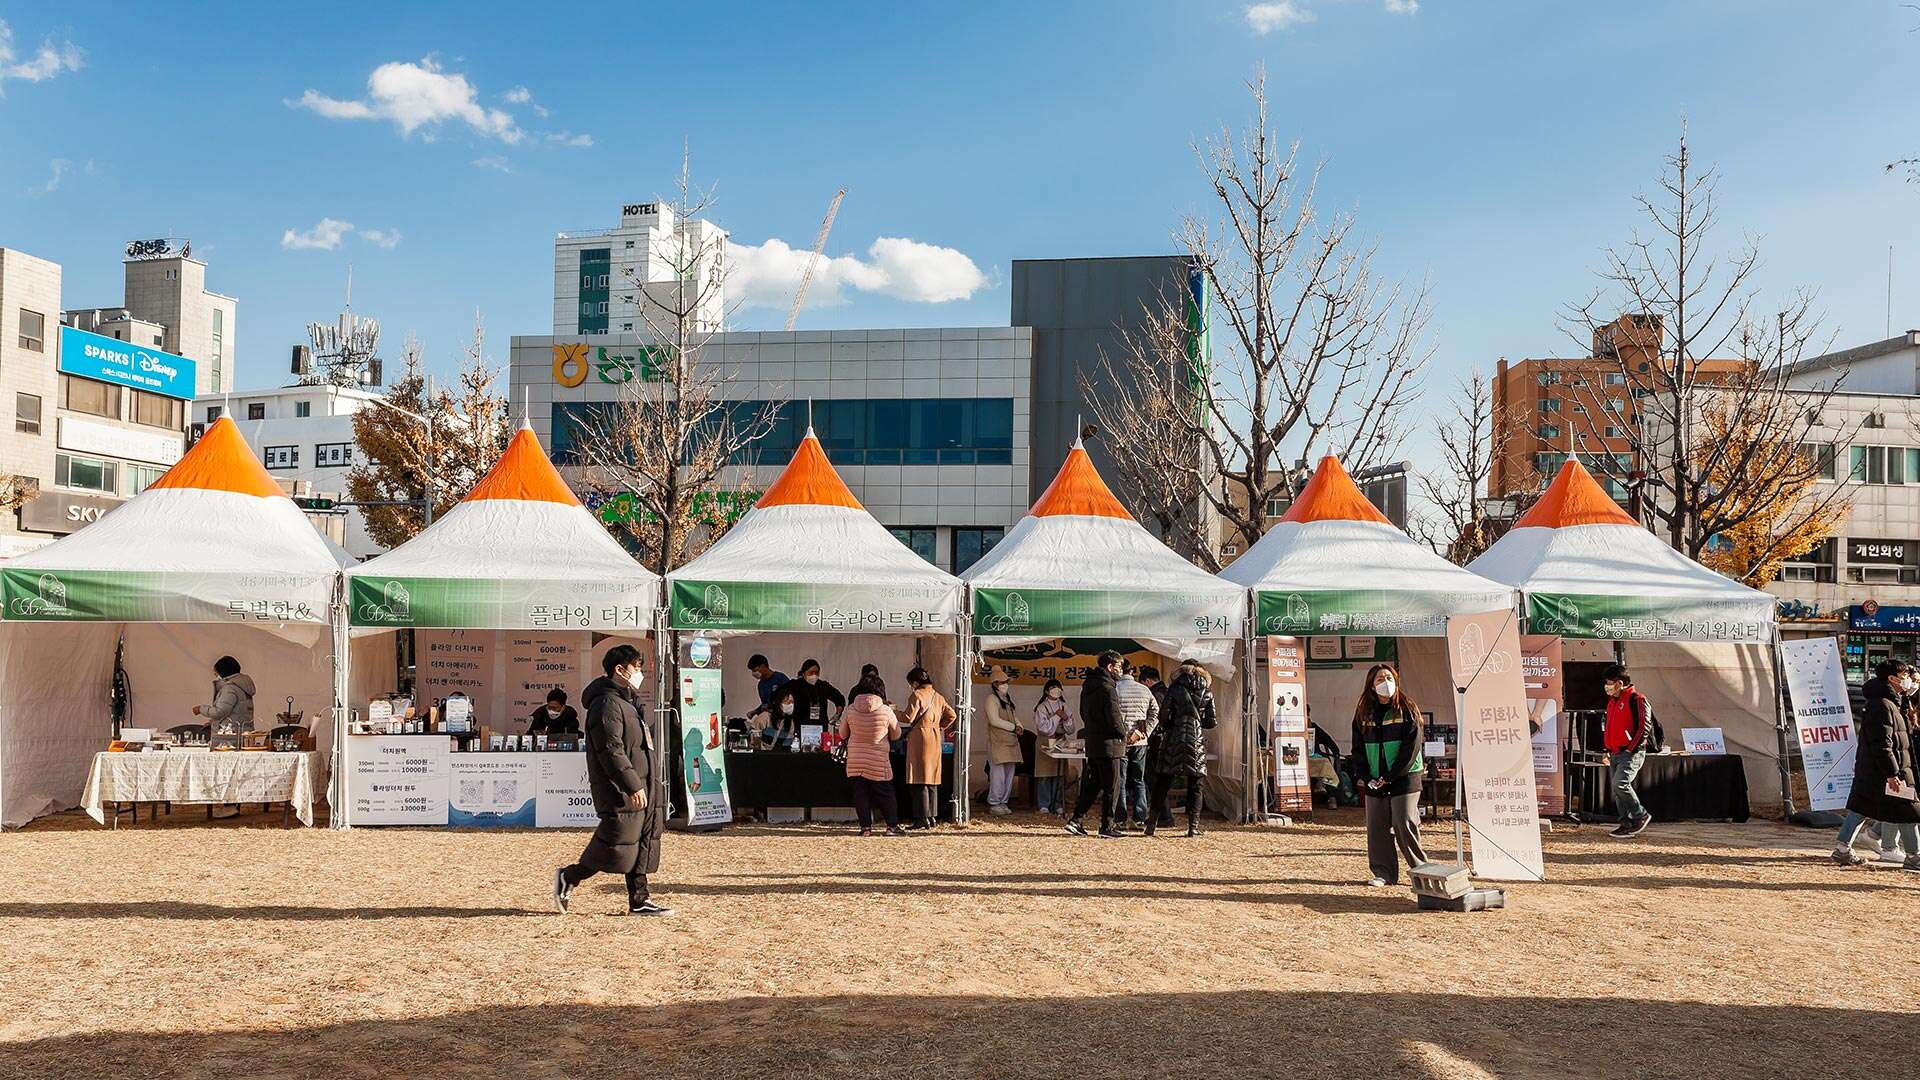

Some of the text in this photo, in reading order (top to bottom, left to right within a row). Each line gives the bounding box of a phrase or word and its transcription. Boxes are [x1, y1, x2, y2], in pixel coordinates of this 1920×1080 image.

[624, 205, 657, 216] HOTEL
[84, 344, 129, 366] SPARKS
[1856, 544, 1904, 558] 개인회생
[227, 600, 314, 621] 특별함&
[530, 605, 639, 627] 플라잉 더치
[807, 609, 944, 631] 하슬라아트월드
[1194, 616, 1230, 635] 할사
[1592, 618, 1761, 640] 강릉문화도시지원센터
[980, 665, 1020, 679] 유농
[1801, 725, 1849, 744] EVENT
[1695, 743, 1715, 751] EVENT
